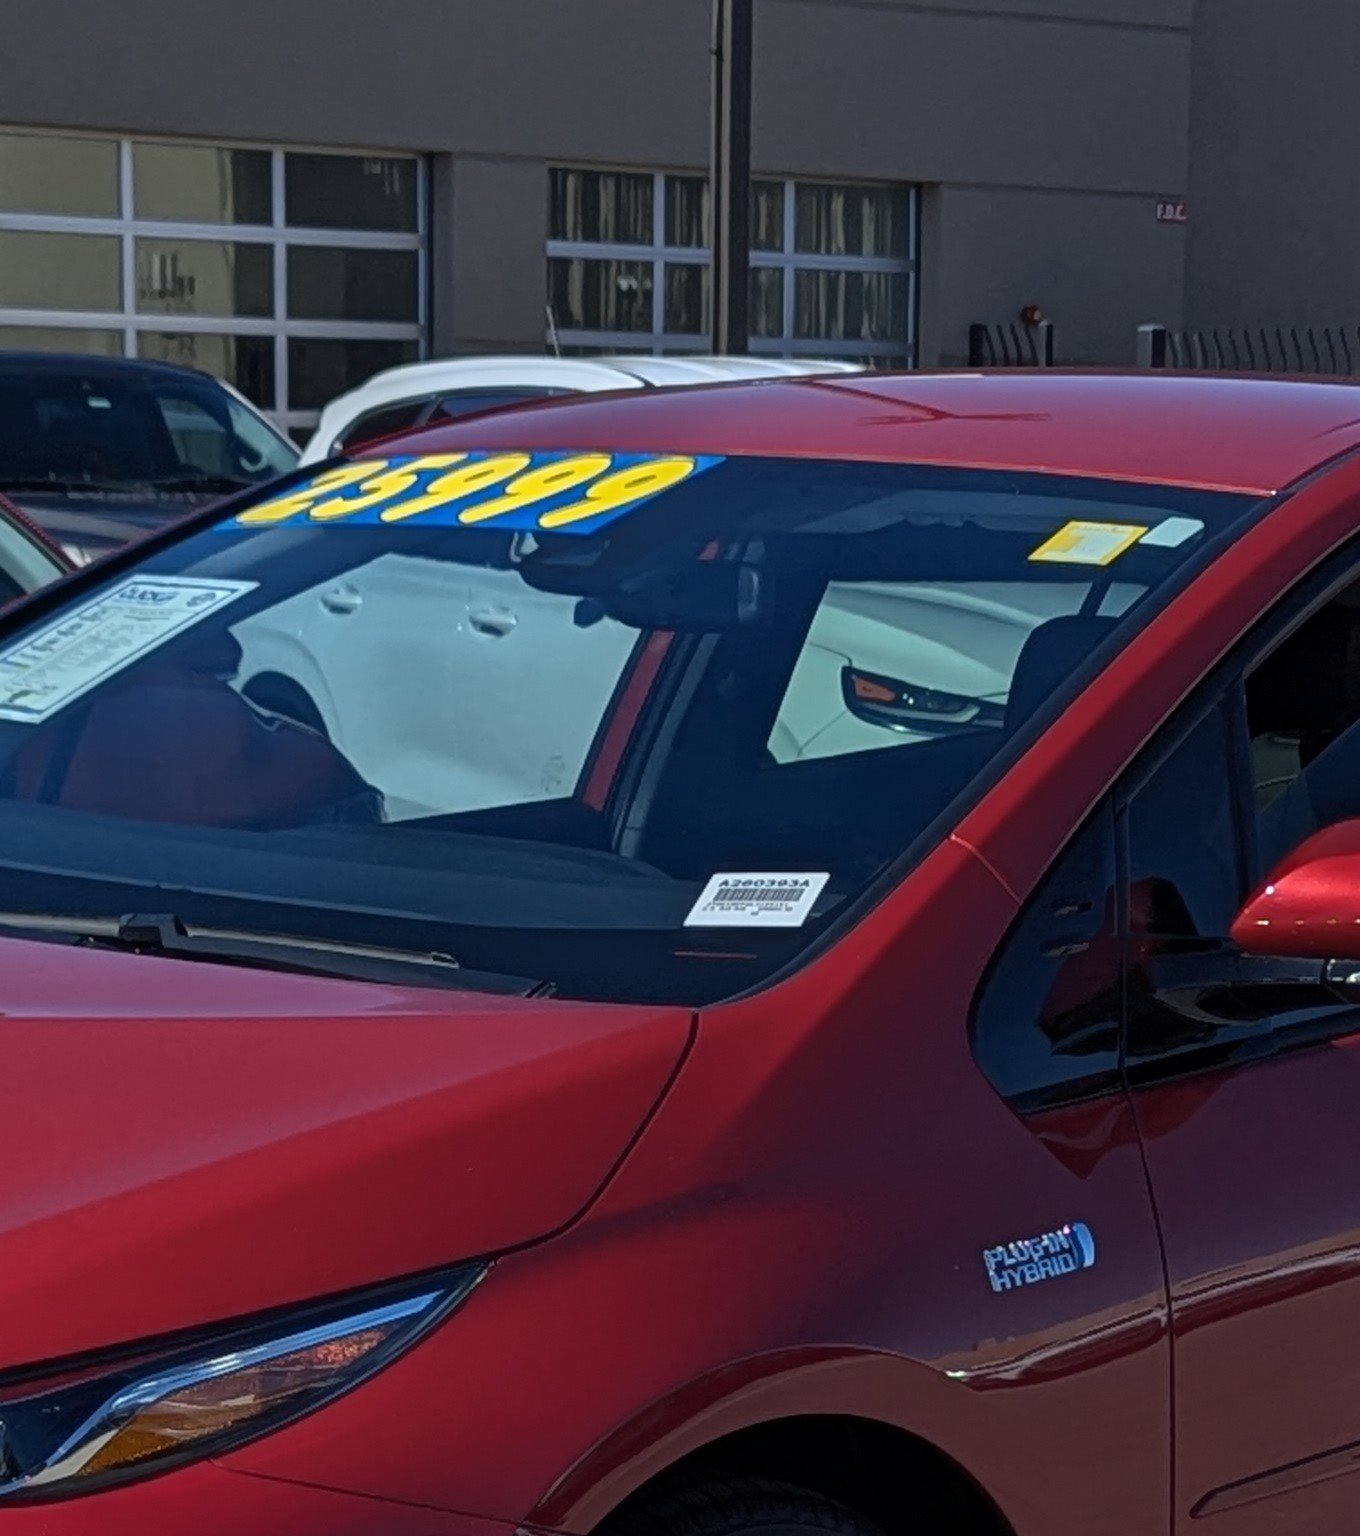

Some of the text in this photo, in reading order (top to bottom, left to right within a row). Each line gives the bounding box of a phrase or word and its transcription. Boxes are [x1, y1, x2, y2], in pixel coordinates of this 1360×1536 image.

[235, 454, 696, 528] 25999
[982, 1224, 1071, 1271] PLUG-IN
[988, 1252, 1078, 1293] HYBRID
